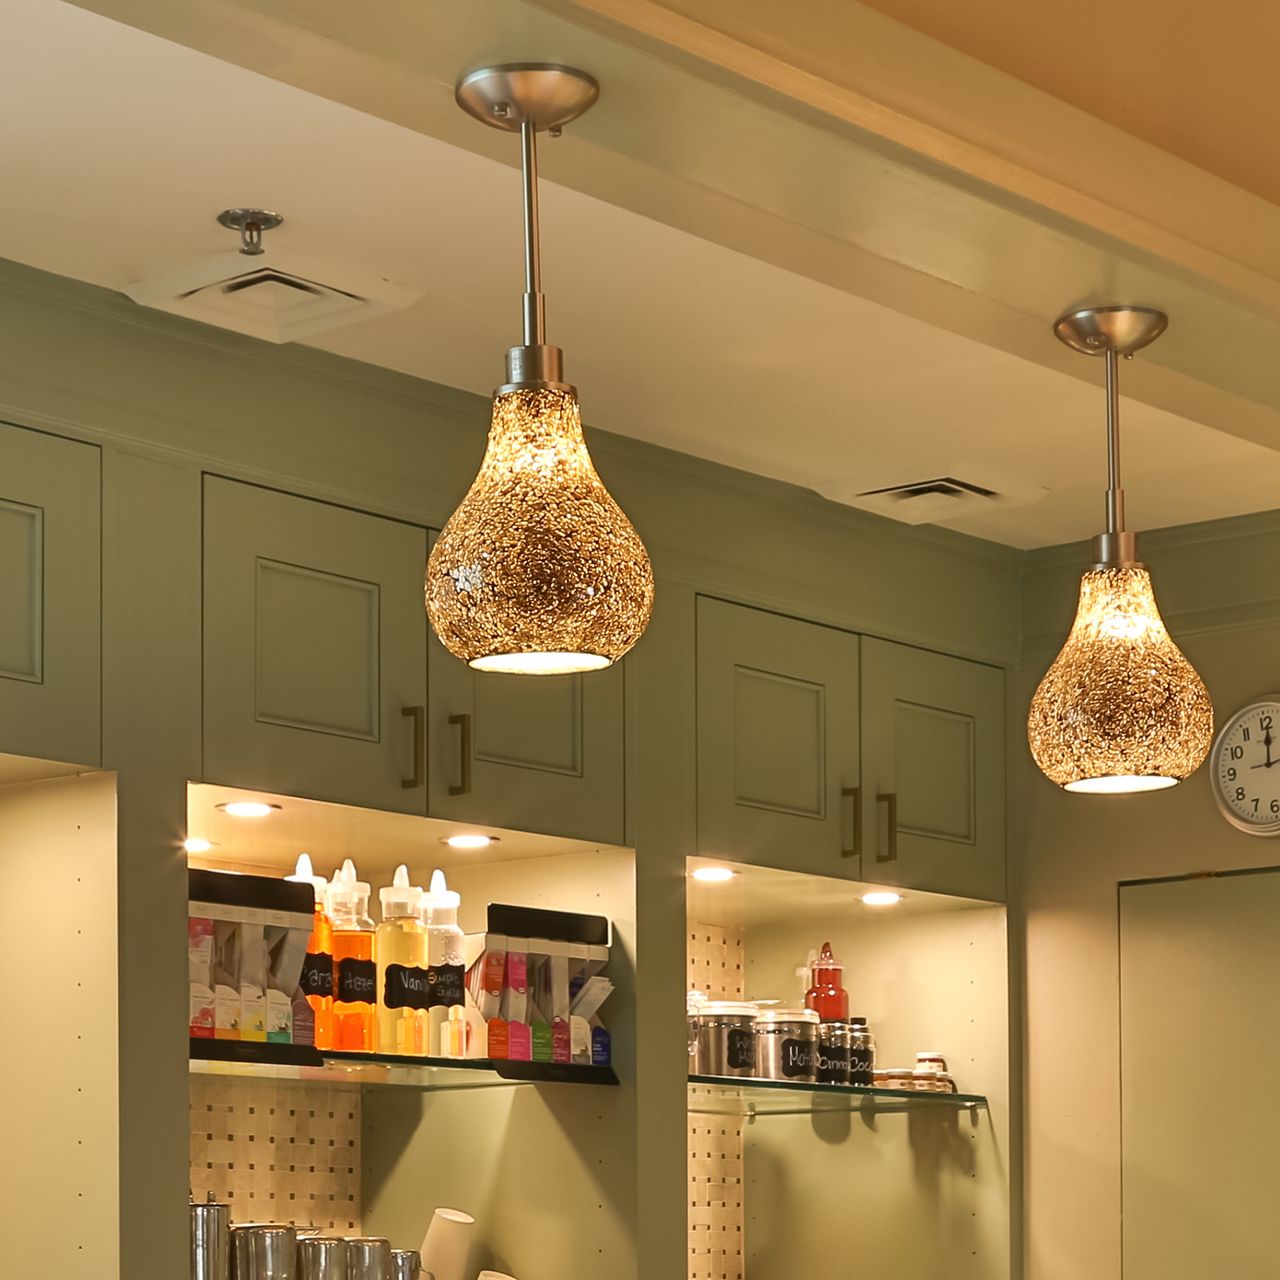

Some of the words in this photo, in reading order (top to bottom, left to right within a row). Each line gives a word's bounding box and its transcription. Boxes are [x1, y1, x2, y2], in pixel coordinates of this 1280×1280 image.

[1259, 715, 1273, 730] 12
[1242, 727, 1250, 742] 11
[1230, 745, 1244, 761] 10
[1227, 767, 1237, 781] 9
[1235, 786, 1246, 801] 8
[1251, 798, 1260, 812] 7
[1269, 799, 1280, 813] 6
